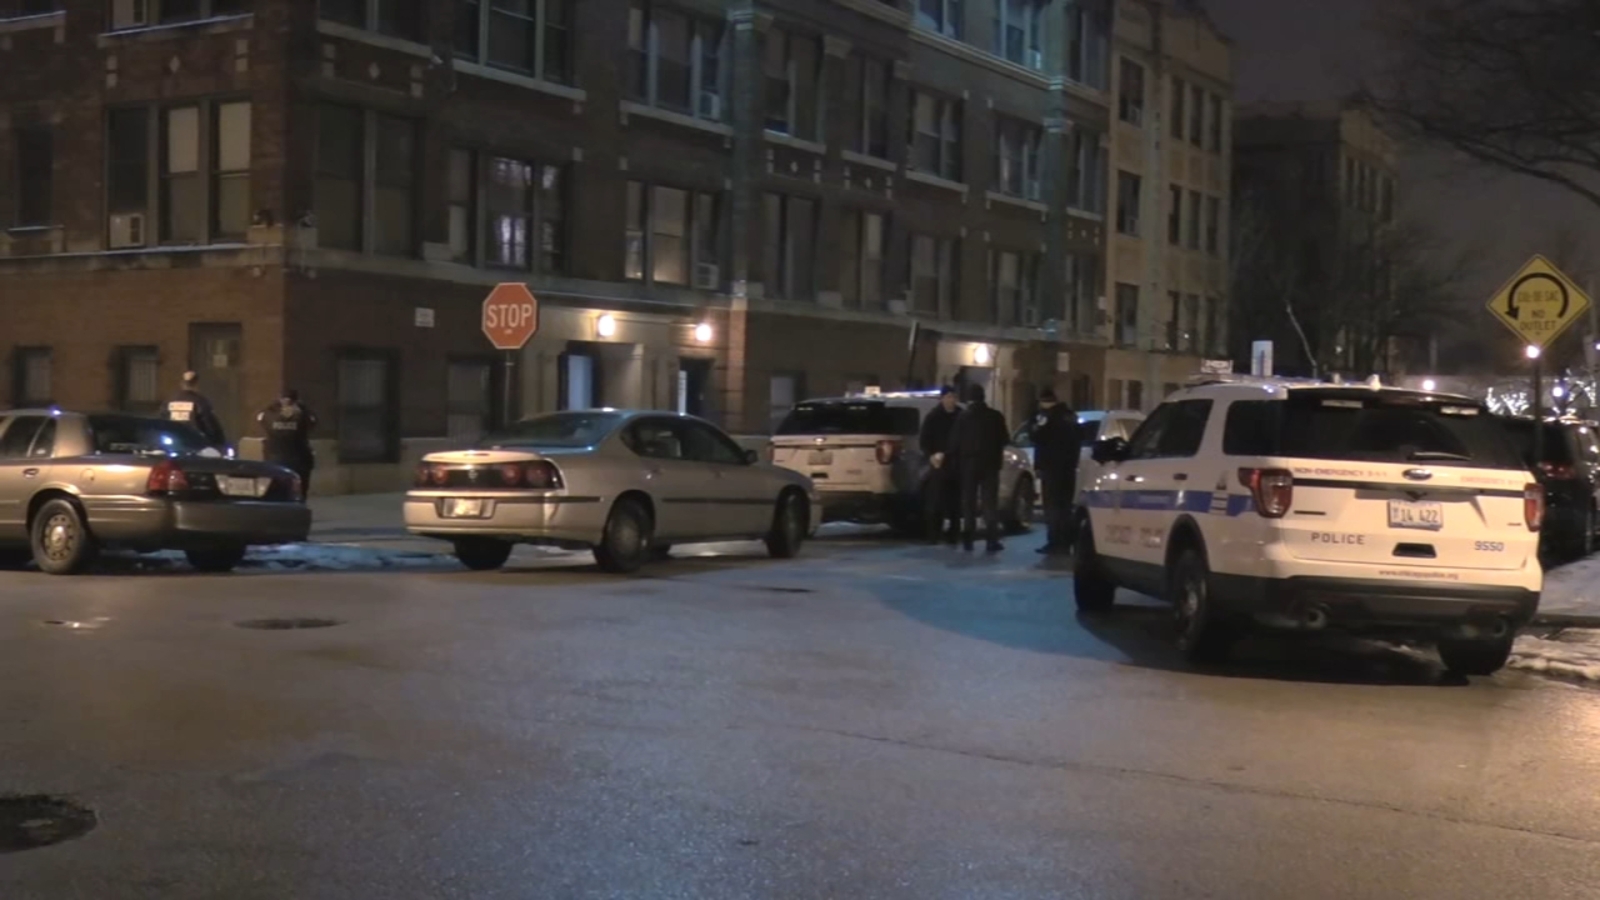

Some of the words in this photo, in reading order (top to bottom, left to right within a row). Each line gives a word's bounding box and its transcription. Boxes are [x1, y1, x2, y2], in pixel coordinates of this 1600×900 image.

[487, 303, 532, 329] STOP
[1531, 309, 1545, 319] NO
[1519, 320, 1556, 331] OUTLET
[1310, 531, 1366, 546] POLICE
[1474, 540, 1504, 552] 9550
